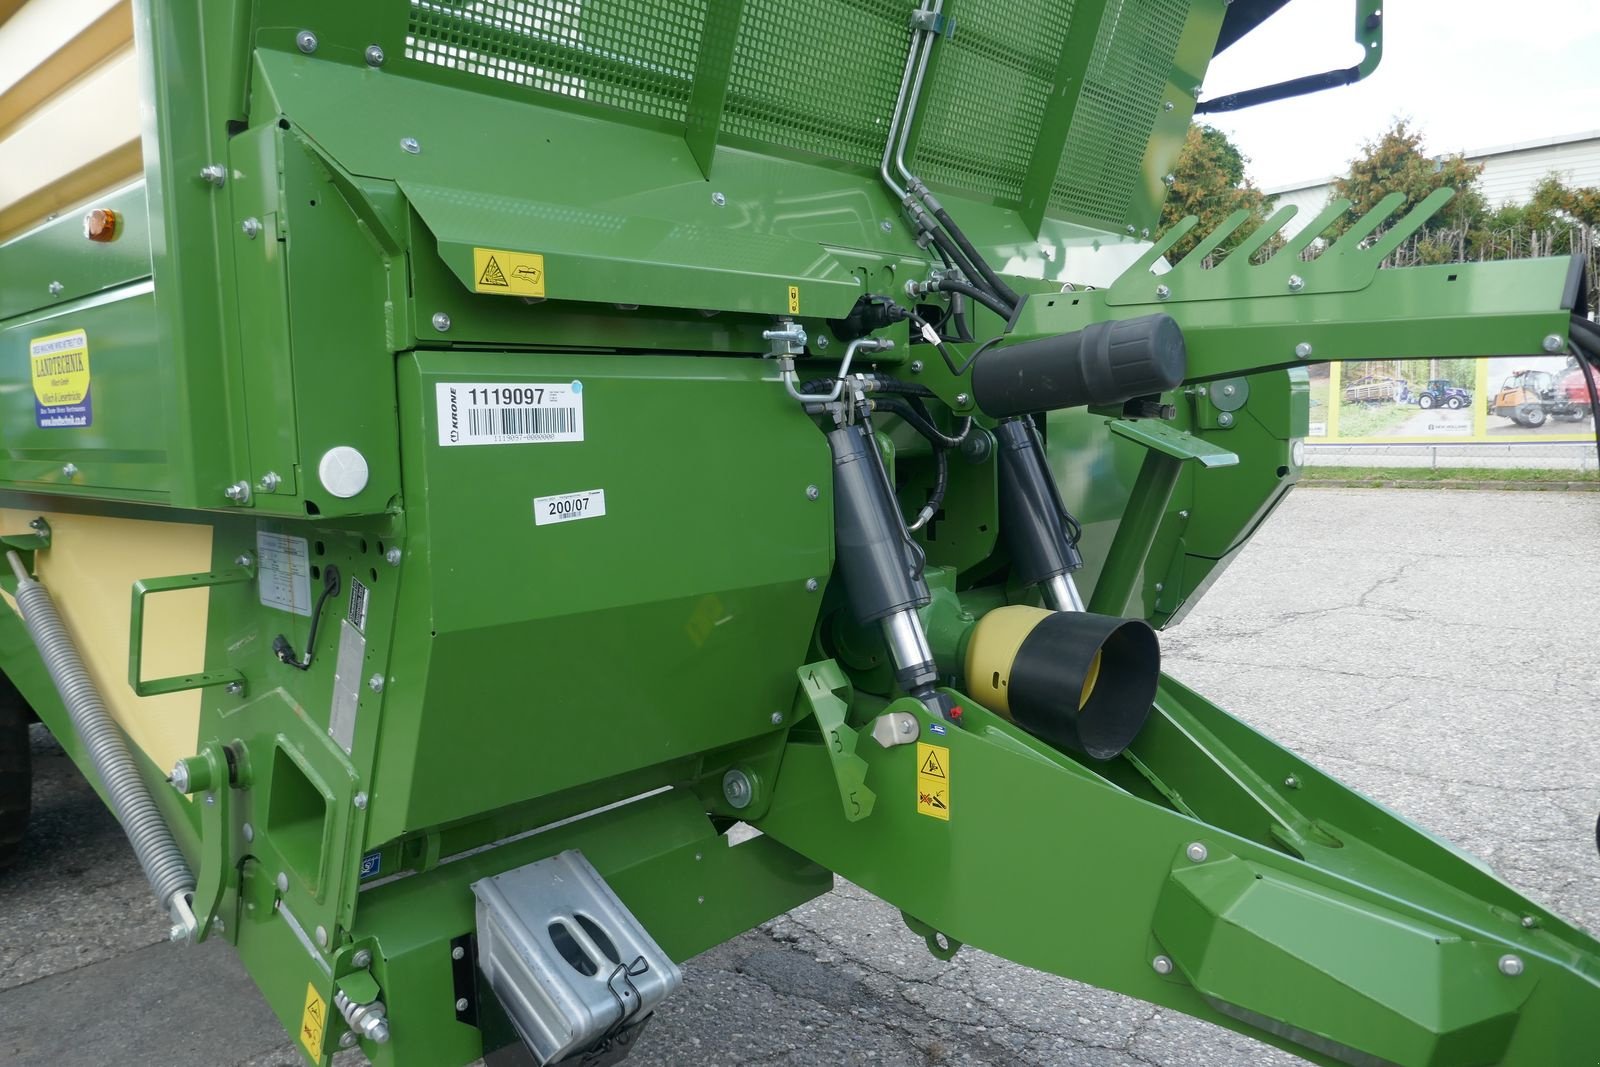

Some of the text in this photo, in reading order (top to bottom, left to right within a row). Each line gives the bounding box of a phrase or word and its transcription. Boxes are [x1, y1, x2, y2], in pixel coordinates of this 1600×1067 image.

[36, 352, 84, 377] LANDTECHNIK
[450, 387, 459, 430] KRONE
[468, 388, 545, 405] 1119097
[548, 497, 590, 515] 200/07
[808, 669, 821, 690] 1
[830, 729, 843, 754] 3
[849, 791, 861, 816] 5
